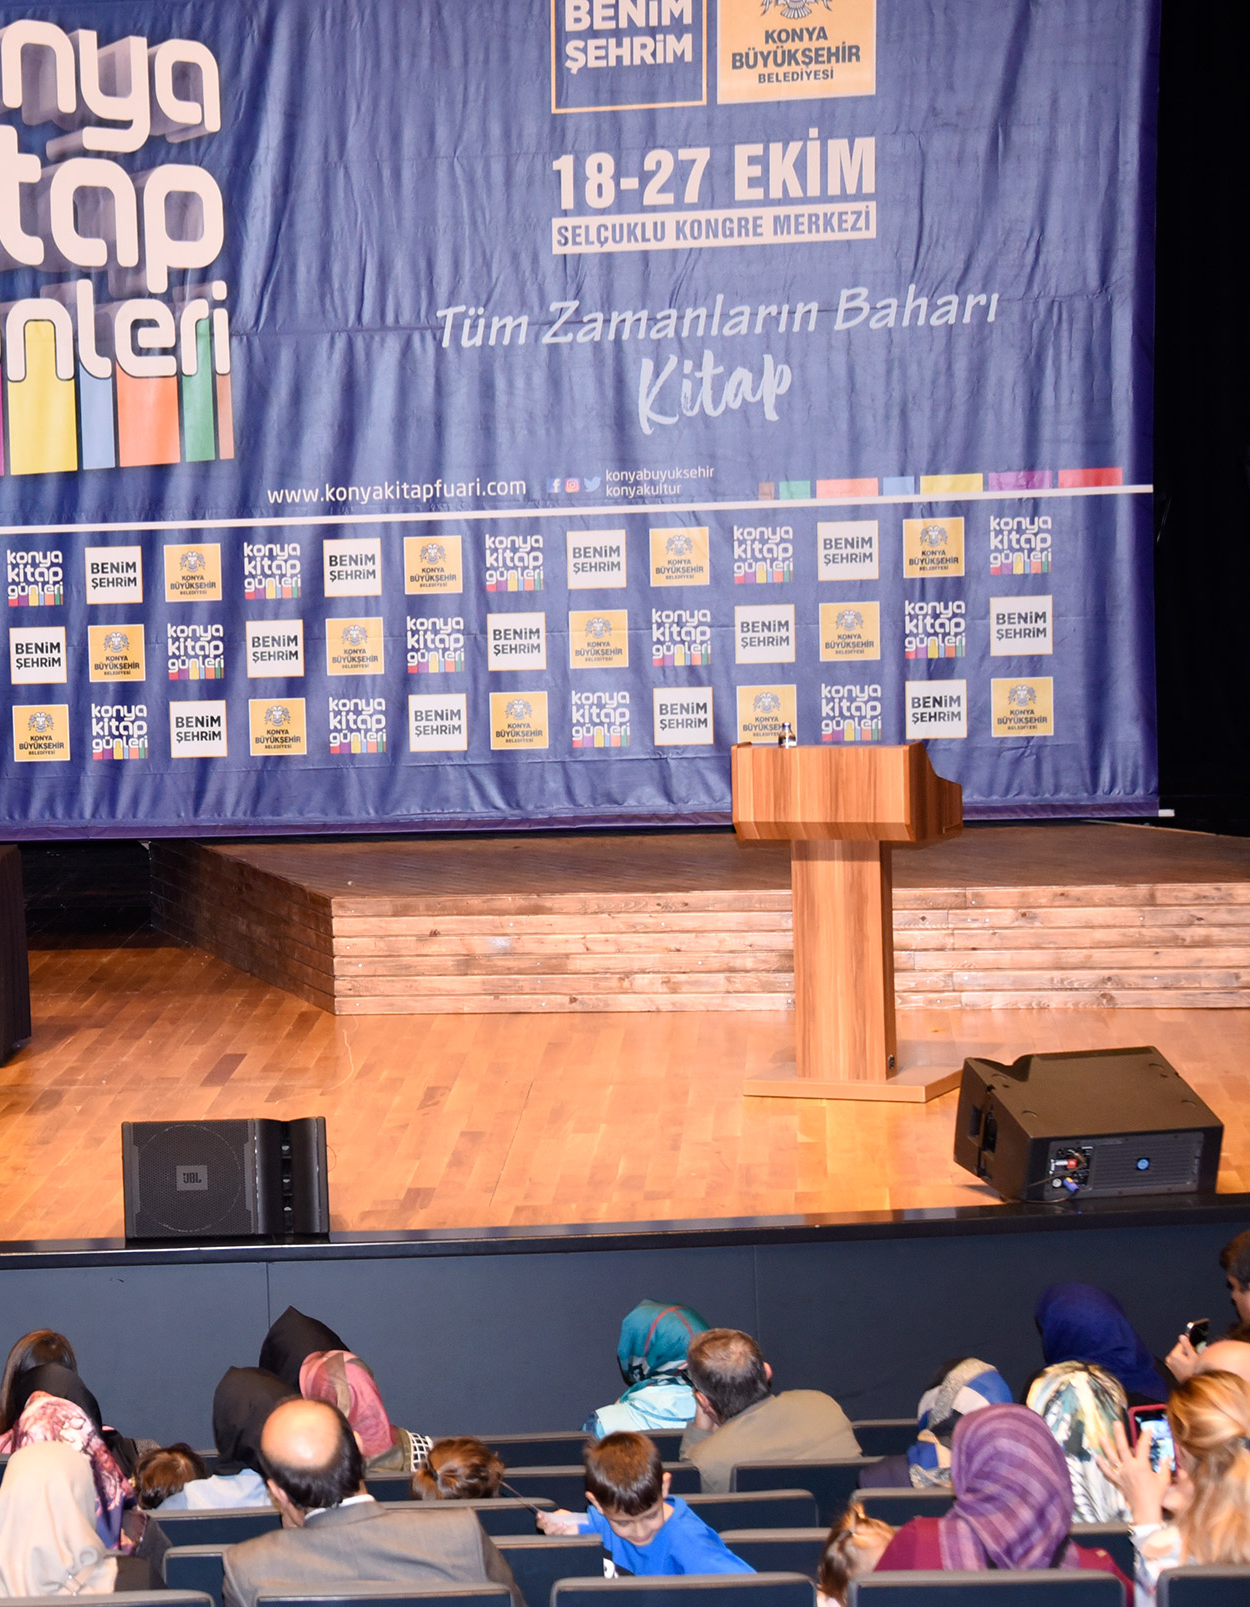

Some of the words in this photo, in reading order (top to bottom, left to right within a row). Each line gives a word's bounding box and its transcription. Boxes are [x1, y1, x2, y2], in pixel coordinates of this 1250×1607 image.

[764, 26, 829, 45] KONYA
[731, 45, 861, 71] BÜYÜKŞEHİR
[758, 69, 834, 84] BELEDİYESİ
[552, 146, 710, 210] 18-27
[734, 127, 876, 201] EKİM
[556, 220, 666, 248] SELÇUKLU
[675, 215, 764, 242] KONGRE
[772, 205, 871, 236] MERKEZİ
[436, 305, 530, 348] Tüm
[542, 294, 820, 344] Zamanların
[834, 283, 999, 331] Baharı
[638, 349, 792, 435] Kitap
[604, 465, 716, 483] konyabuyuksehir
[267, 477, 527, 504] www.konyakitapfuari.com
[605, 481, 682, 498] konyakultur
[990, 514, 1052, 534] konya
[484, 534, 544, 552] konya
[990, 530, 1052, 551] kitap
[6, 550, 62, 568] konya
[485, 548, 544, 569] kitap
[990, 549, 1052, 568] günleri
[7, 564, 63, 584] kitap
[485, 567, 544, 585] günleri
[8, 582, 64, 600] günleri
[652, 608, 712, 627] konya
[166, 622, 224, 641] konya
[652, 623, 712, 644] kitap
[167, 637, 224, 658] kitap
[652, 641, 712, 659] günleri
[167, 655, 224, 673] günleri
[570, 690, 631, 710] konya
[92, 704, 148, 722] konya
[571, 705, 631, 726] kitap
[92, 718, 148, 738] kitap
[571, 724, 632, 742] günleri
[92, 736, 148, 754] günleri
[182, 1172, 202, 1184] JBL
